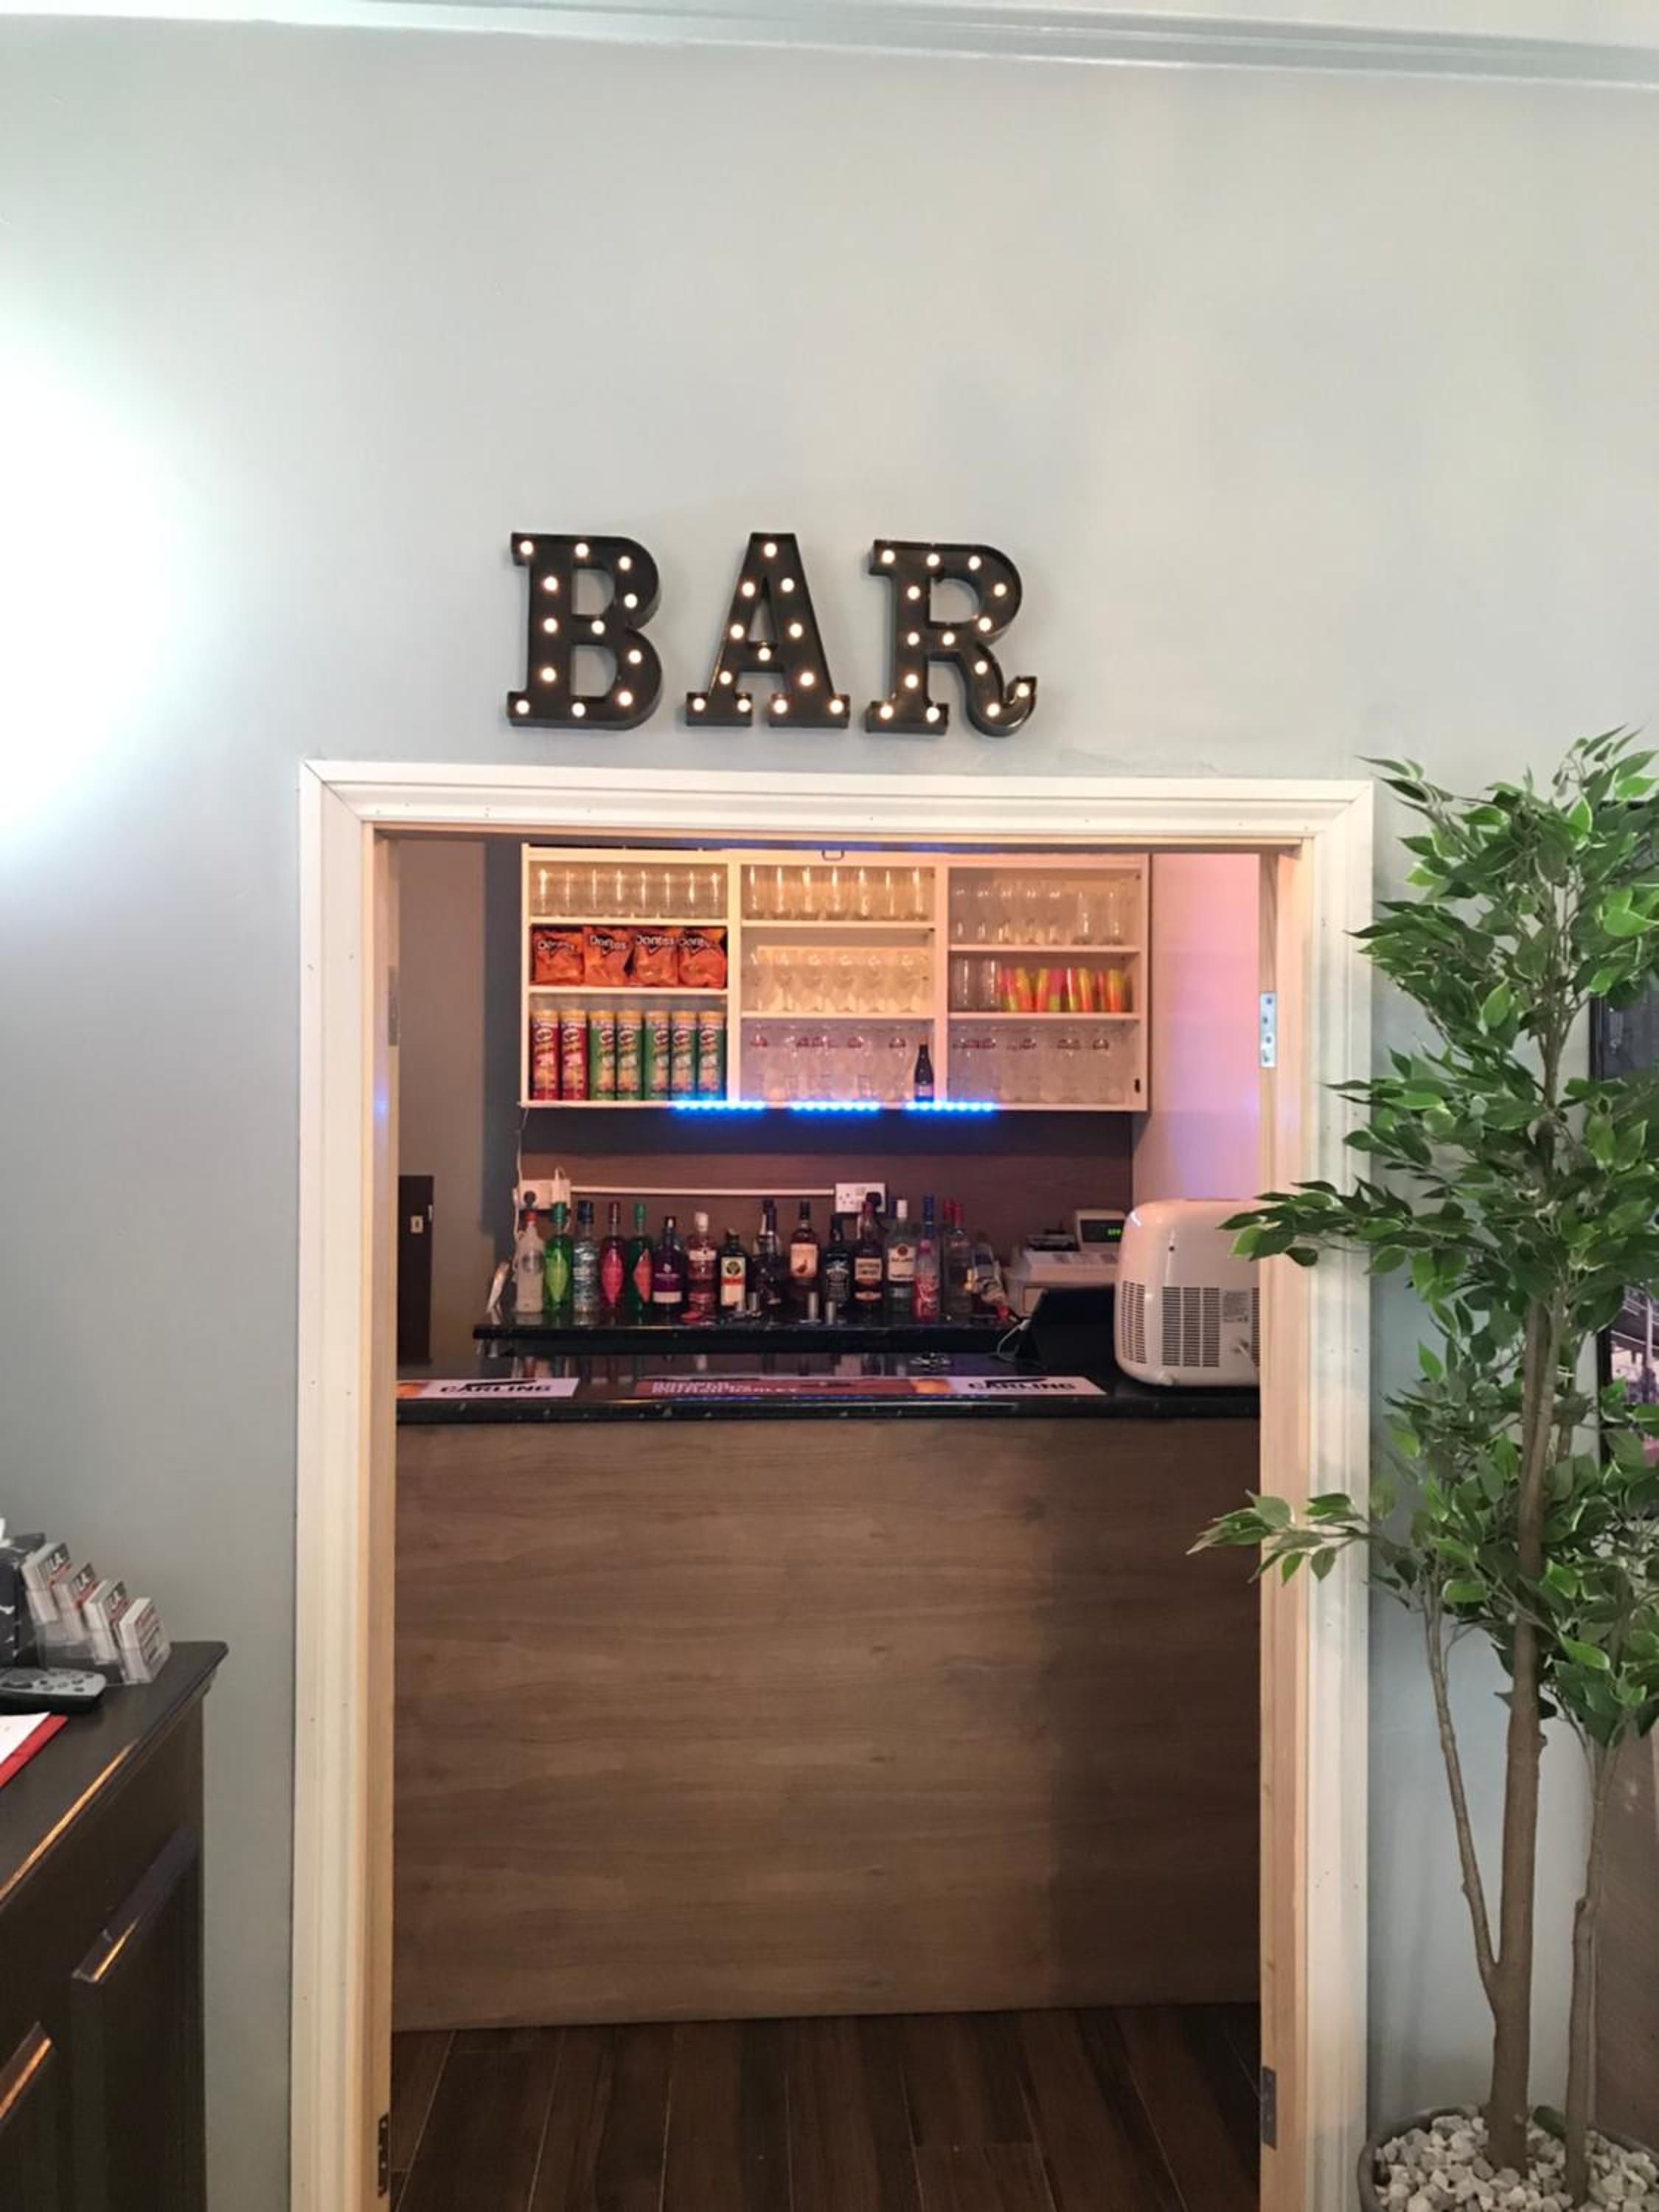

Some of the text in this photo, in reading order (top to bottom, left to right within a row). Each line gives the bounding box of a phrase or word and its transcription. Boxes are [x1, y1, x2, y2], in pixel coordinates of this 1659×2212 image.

[508, 532, 1037, 737] BAR
[440, 1380, 552, 1393] CARLING
[967, 1379, 1076, 1390] CARLING
